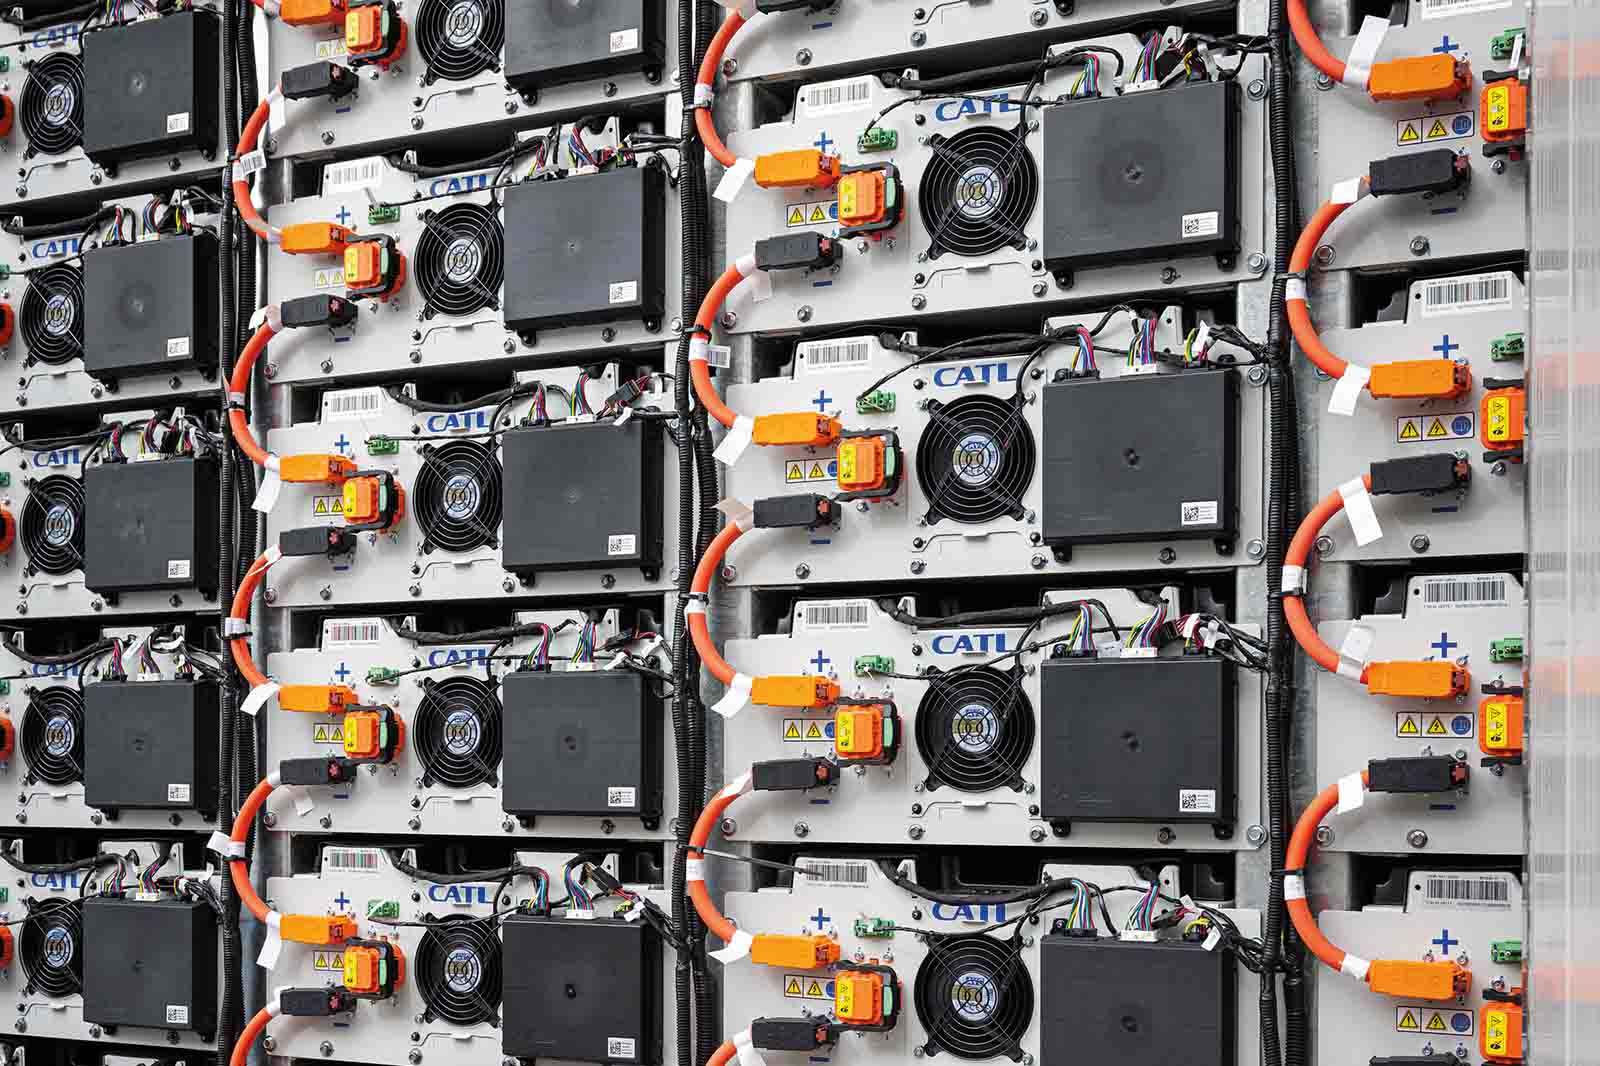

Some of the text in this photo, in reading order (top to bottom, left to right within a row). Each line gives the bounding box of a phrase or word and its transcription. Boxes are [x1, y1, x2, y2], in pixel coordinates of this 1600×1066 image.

[935, 92, 1020, 121] CATL
[431, 174, 488, 197] CATL
[32, 239, 79, 258] CATL
[933, 362, 1016, 387] CATL
[427, 411, 490, 432] CATL
[33, 449, 80, 467] CATL
[932, 632, 1015, 655] CATL
[428, 648, 494, 667] CATL
[32, 871, 81, 888] CATL
[428, 884, 494, 903] CATL
[931, 902, 1007, 923] CATL
